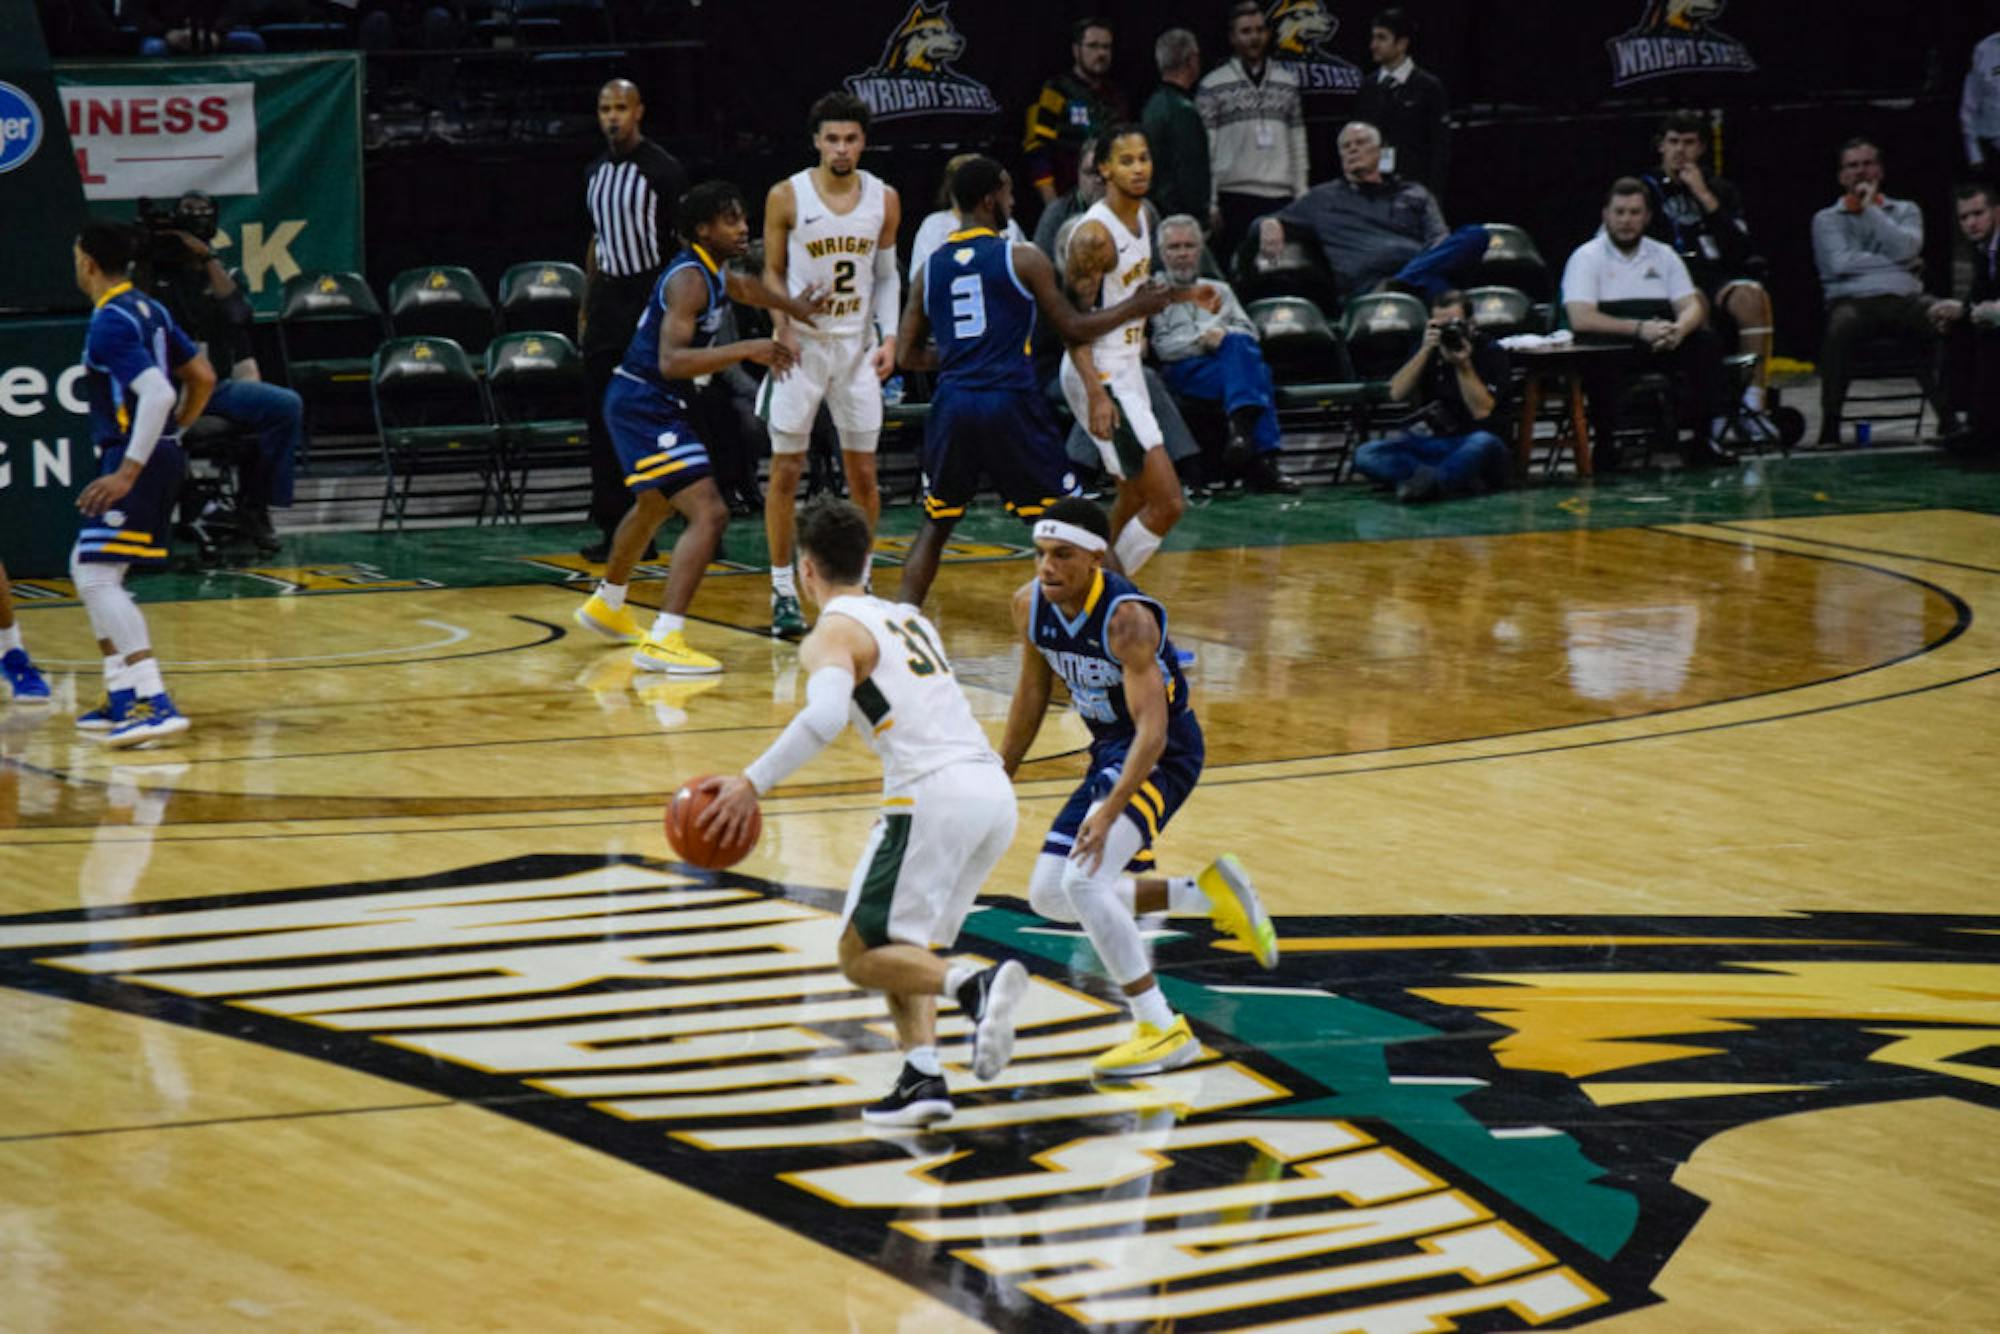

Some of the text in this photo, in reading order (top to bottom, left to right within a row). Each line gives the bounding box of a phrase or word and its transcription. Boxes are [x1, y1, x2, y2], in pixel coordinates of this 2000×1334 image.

[1615, 38, 1697, 77] WRIGHT
[67, 96, 229, 136] INESS
[853, 79, 993, 115] WRIGHT STATE
[210, 219, 308, 294] K
[805, 236, 874, 259] WRIGHT
[834, 260, 856, 294] 2
[950, 273, 988, 340] 3
